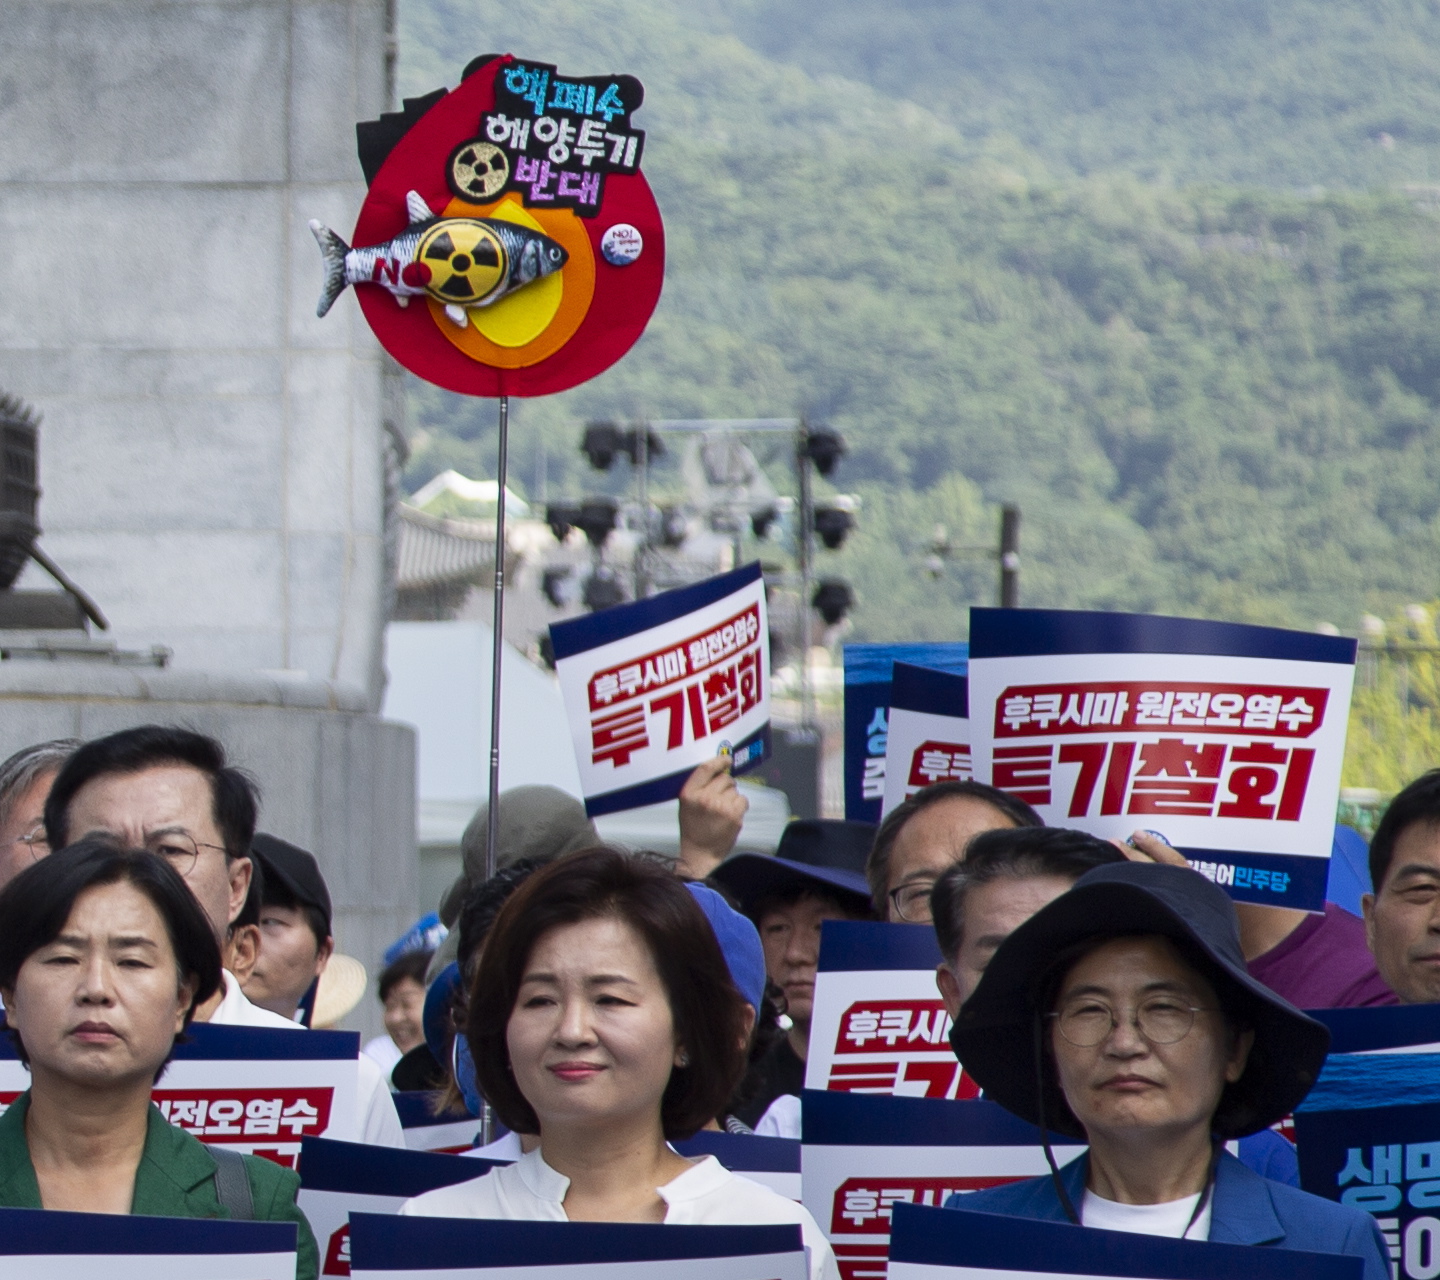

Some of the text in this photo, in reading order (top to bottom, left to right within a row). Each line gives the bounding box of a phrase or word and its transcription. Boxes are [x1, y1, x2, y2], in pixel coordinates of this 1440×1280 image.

[486, 114, 638, 167] 해양투기
[515, 156, 601, 205] 반대
[595, 611, 759, 703] 후쿠시마 원전오염수
[591, 646, 762, 767] 투기철회
[1003, 691, 1313, 730] 후쿠시마 원전오염수
[991, 738, 1315, 821] 투기철회
[845, 1008, 951, 1046] 후쿠시
